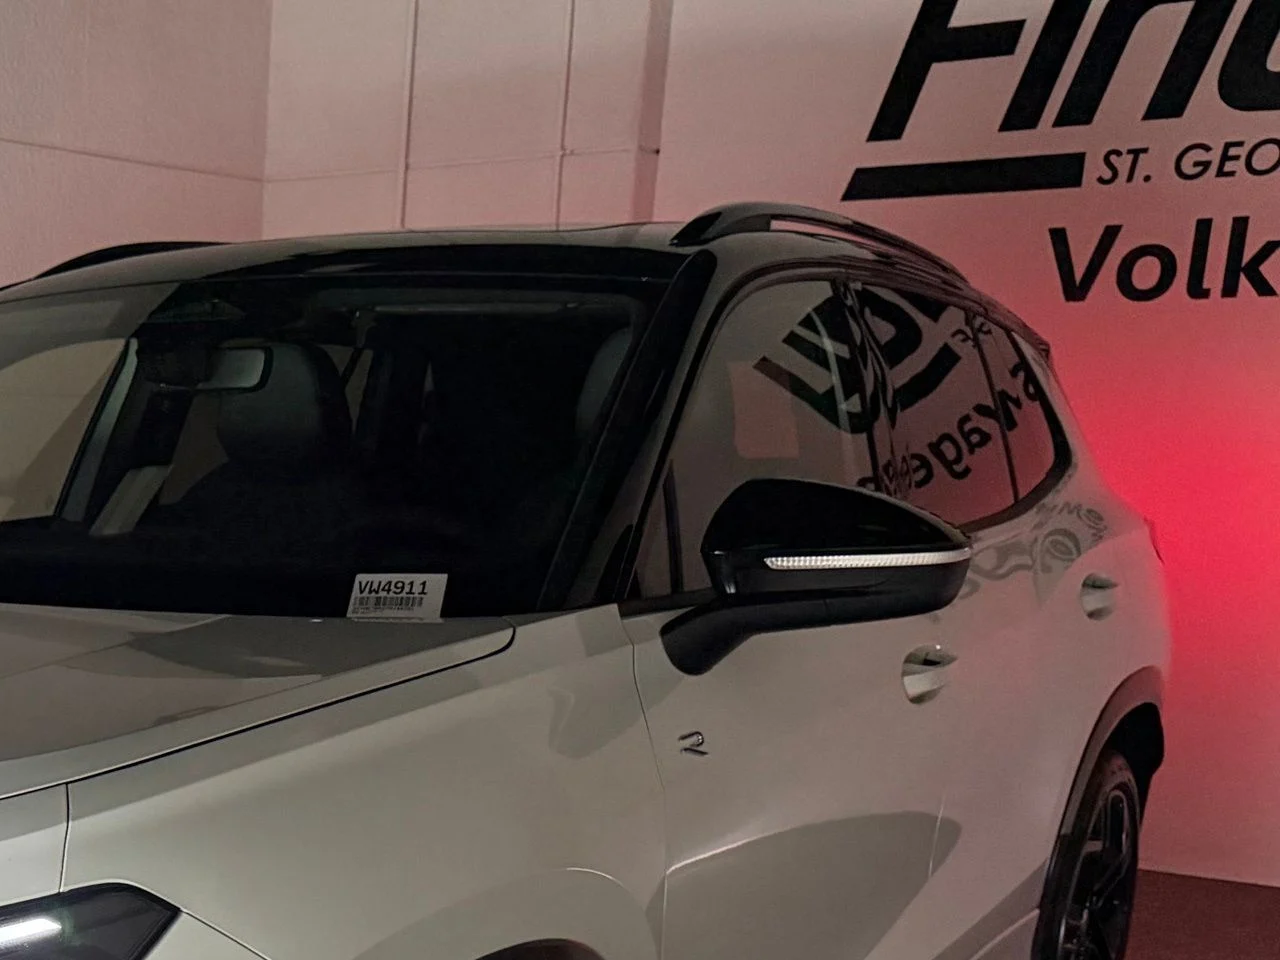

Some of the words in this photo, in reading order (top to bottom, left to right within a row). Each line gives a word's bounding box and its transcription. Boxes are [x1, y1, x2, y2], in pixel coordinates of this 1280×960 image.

[1096, 147, 1152, 186] ST.
[1049, 216, 1280, 303] Volk
[358, 580, 428, 596] VW4911
